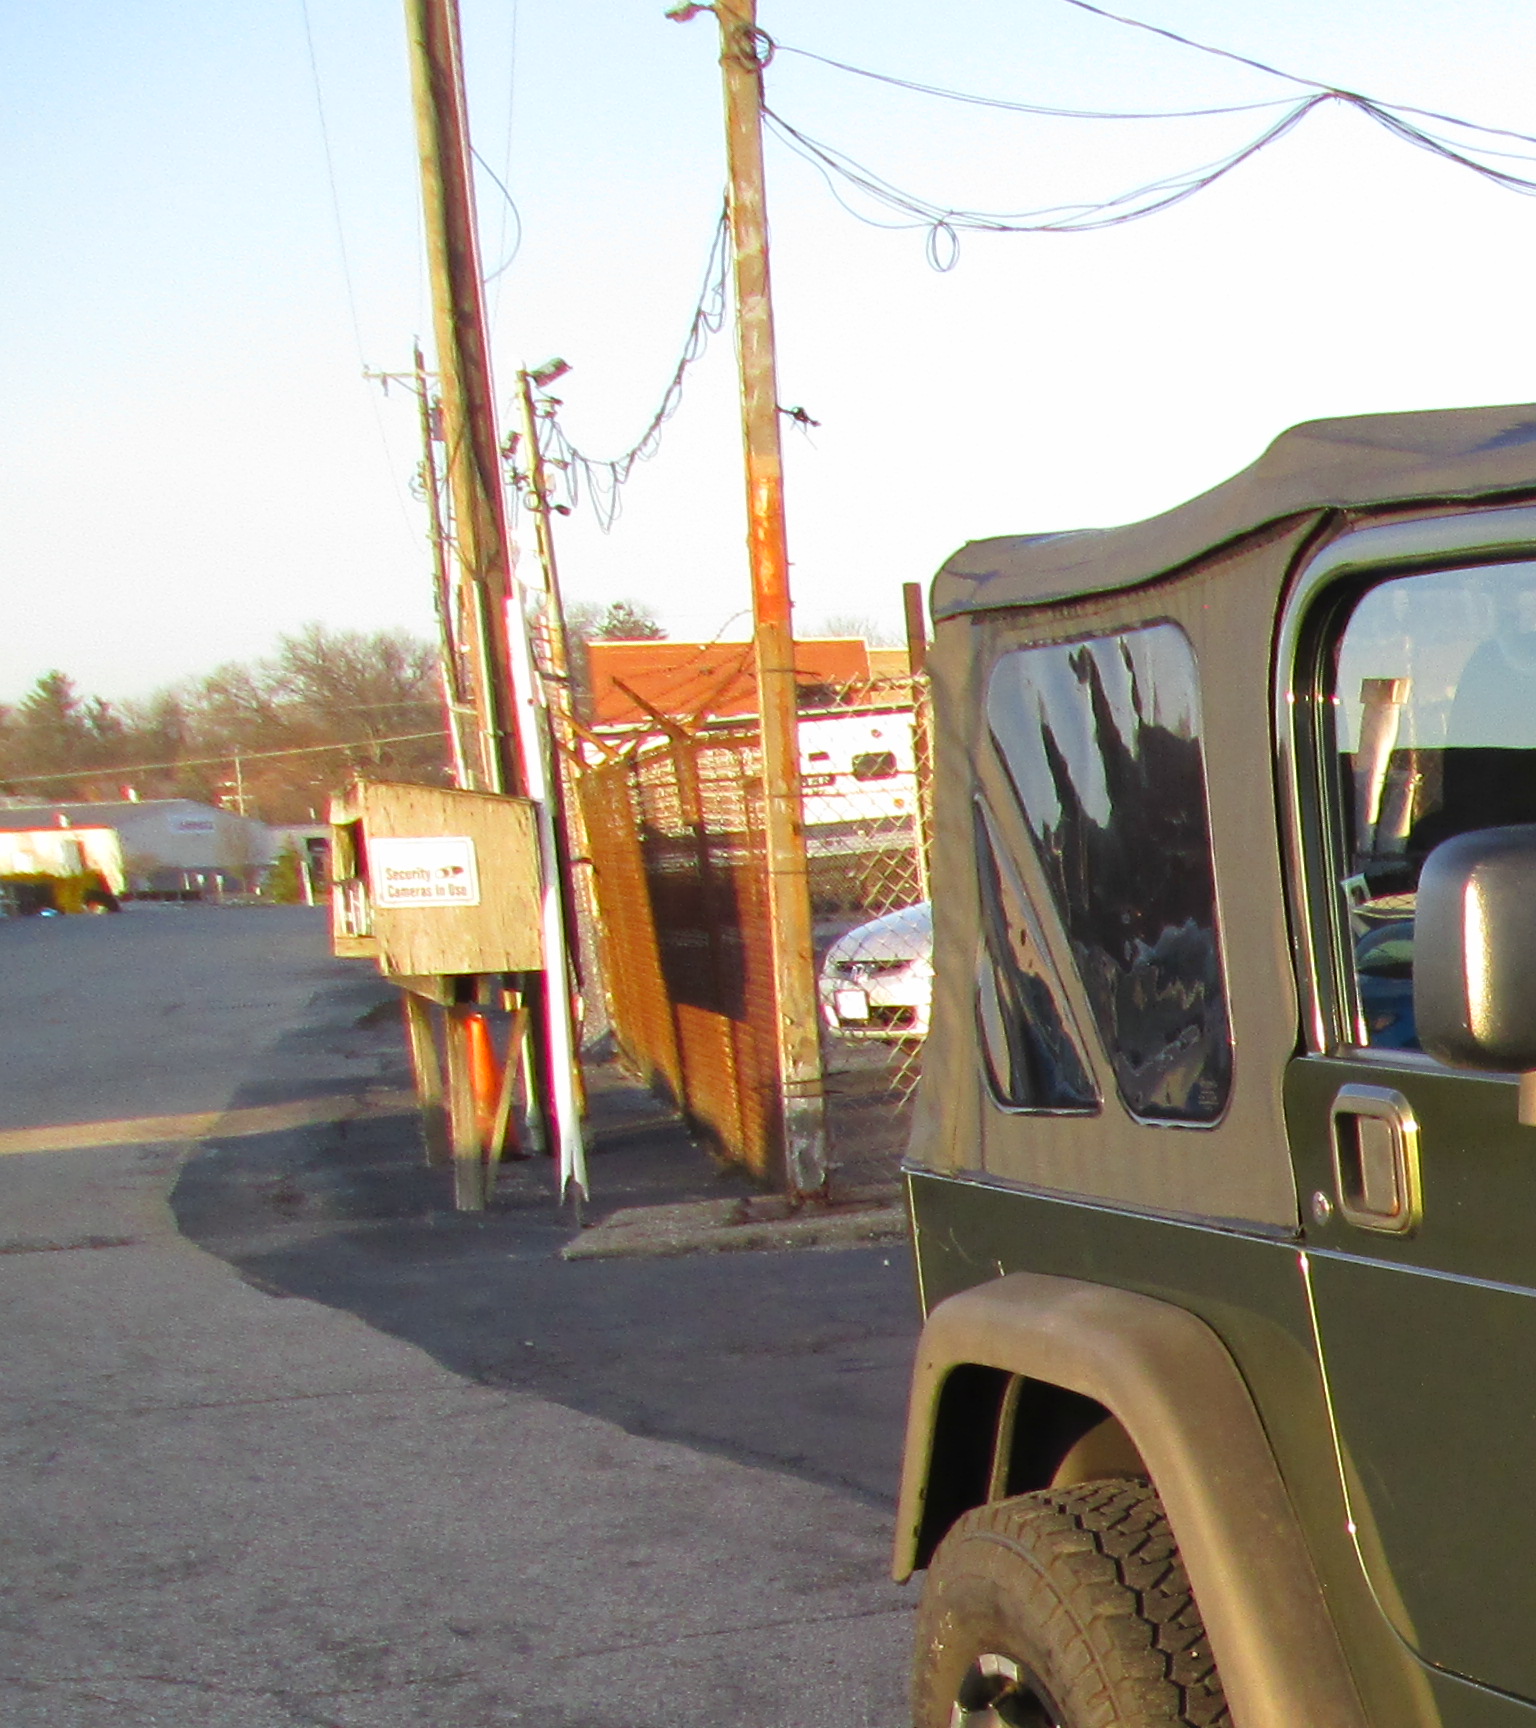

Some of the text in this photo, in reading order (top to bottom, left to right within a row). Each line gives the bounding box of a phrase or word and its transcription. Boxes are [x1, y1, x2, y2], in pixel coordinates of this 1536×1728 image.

[385, 867, 430, 882] Security
[387, 884, 433, 897] Cameras
[448, 883, 467, 896] Use
